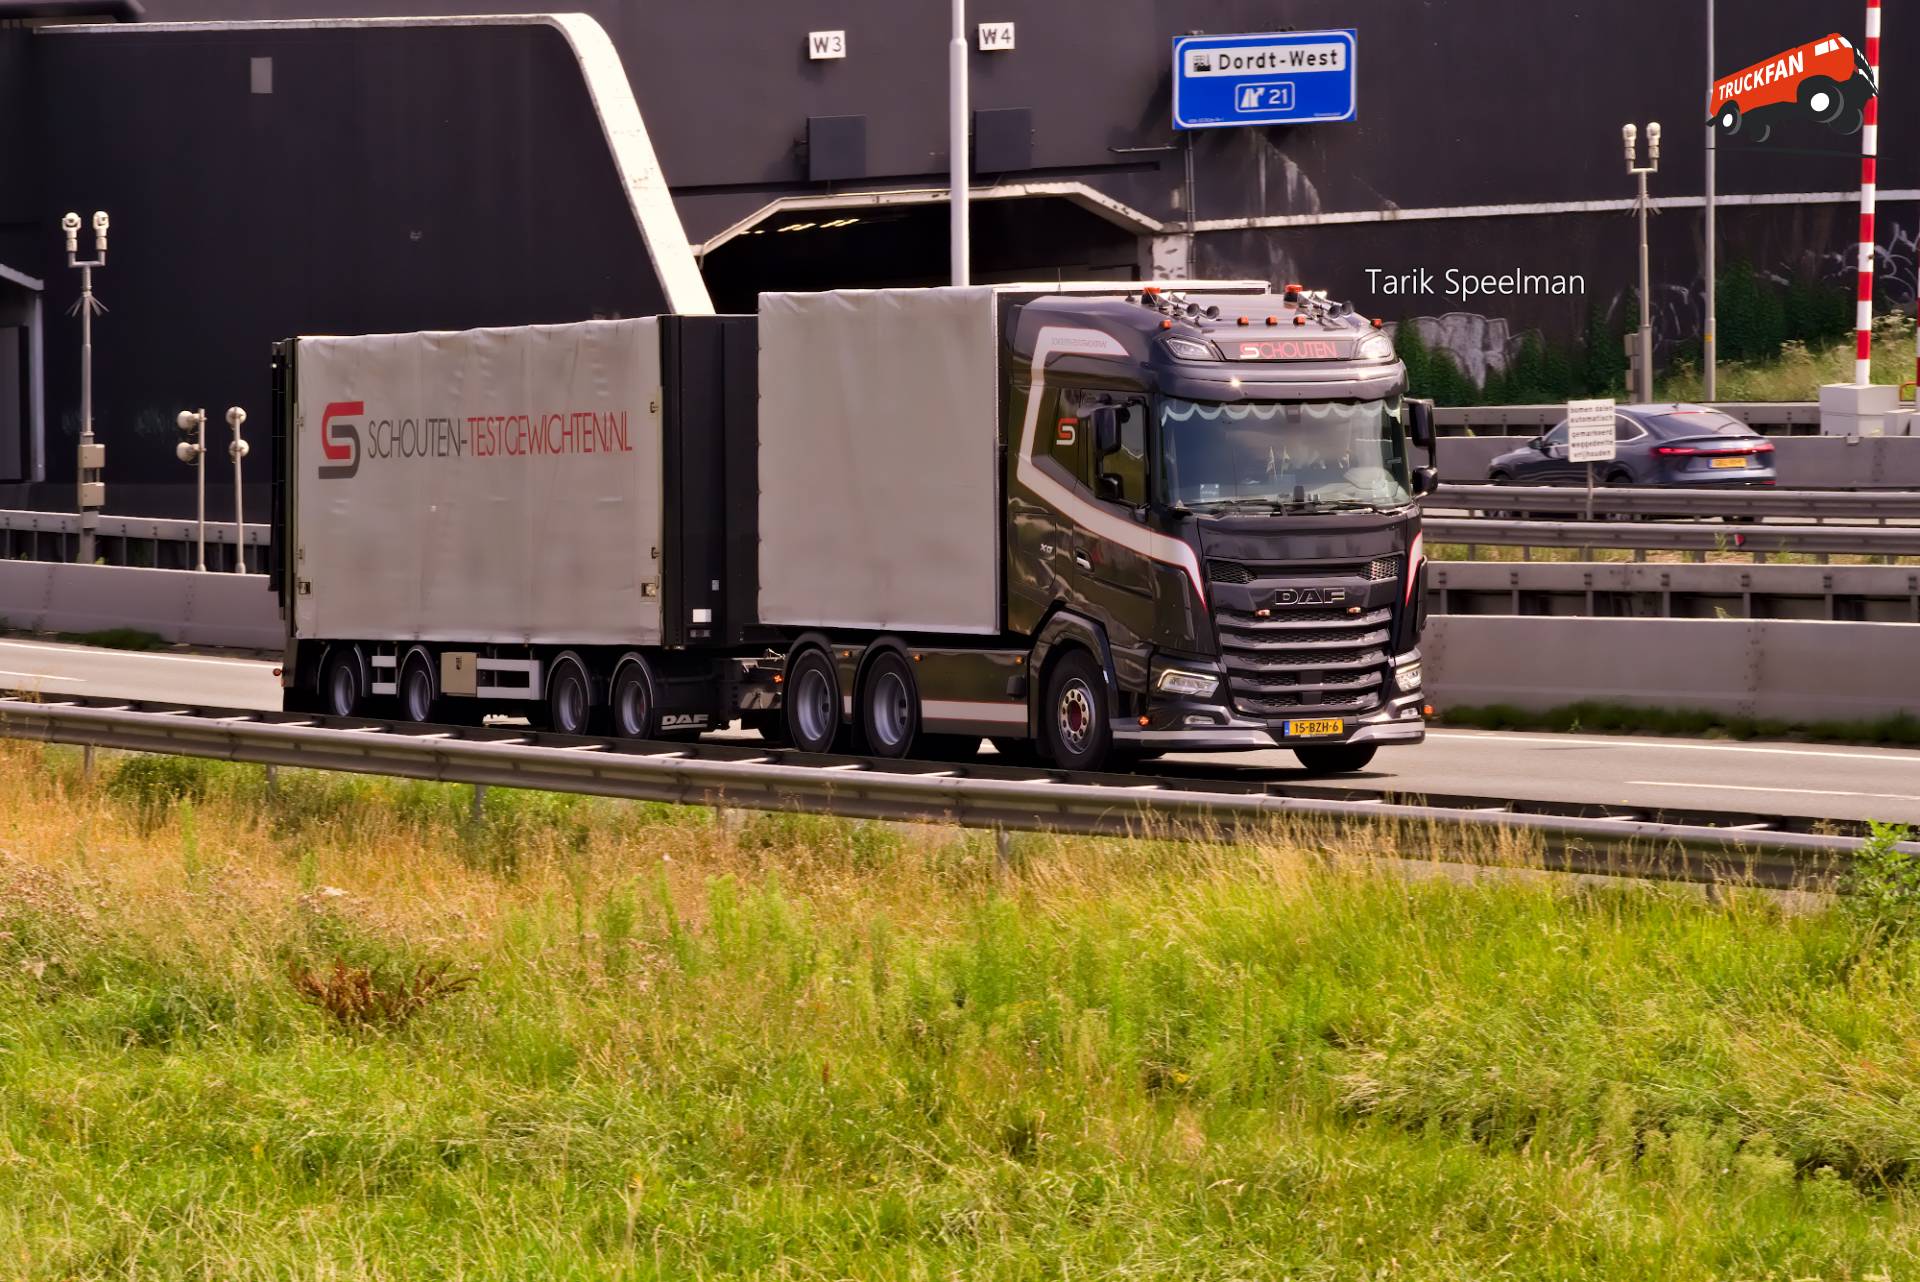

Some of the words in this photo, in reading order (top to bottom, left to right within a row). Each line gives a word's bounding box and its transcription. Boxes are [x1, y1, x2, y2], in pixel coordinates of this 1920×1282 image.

[814, 36, 842, 53] W3
[982, 28, 1012, 45] W4
[1219, 49, 1338, 70] Dordt-West
[1268, 88, 1288, 104] 21
[1240, 341, 1337, 359] SCHOUTEN
[368, 411, 633, 459] SCHOUTEN-TESTGEWICHTEN.NL
[1275, 588, 1345, 605] DAF
[661, 714, 710, 726] DAF
[1294, 721, 1340, 733] 15-BZH-6
